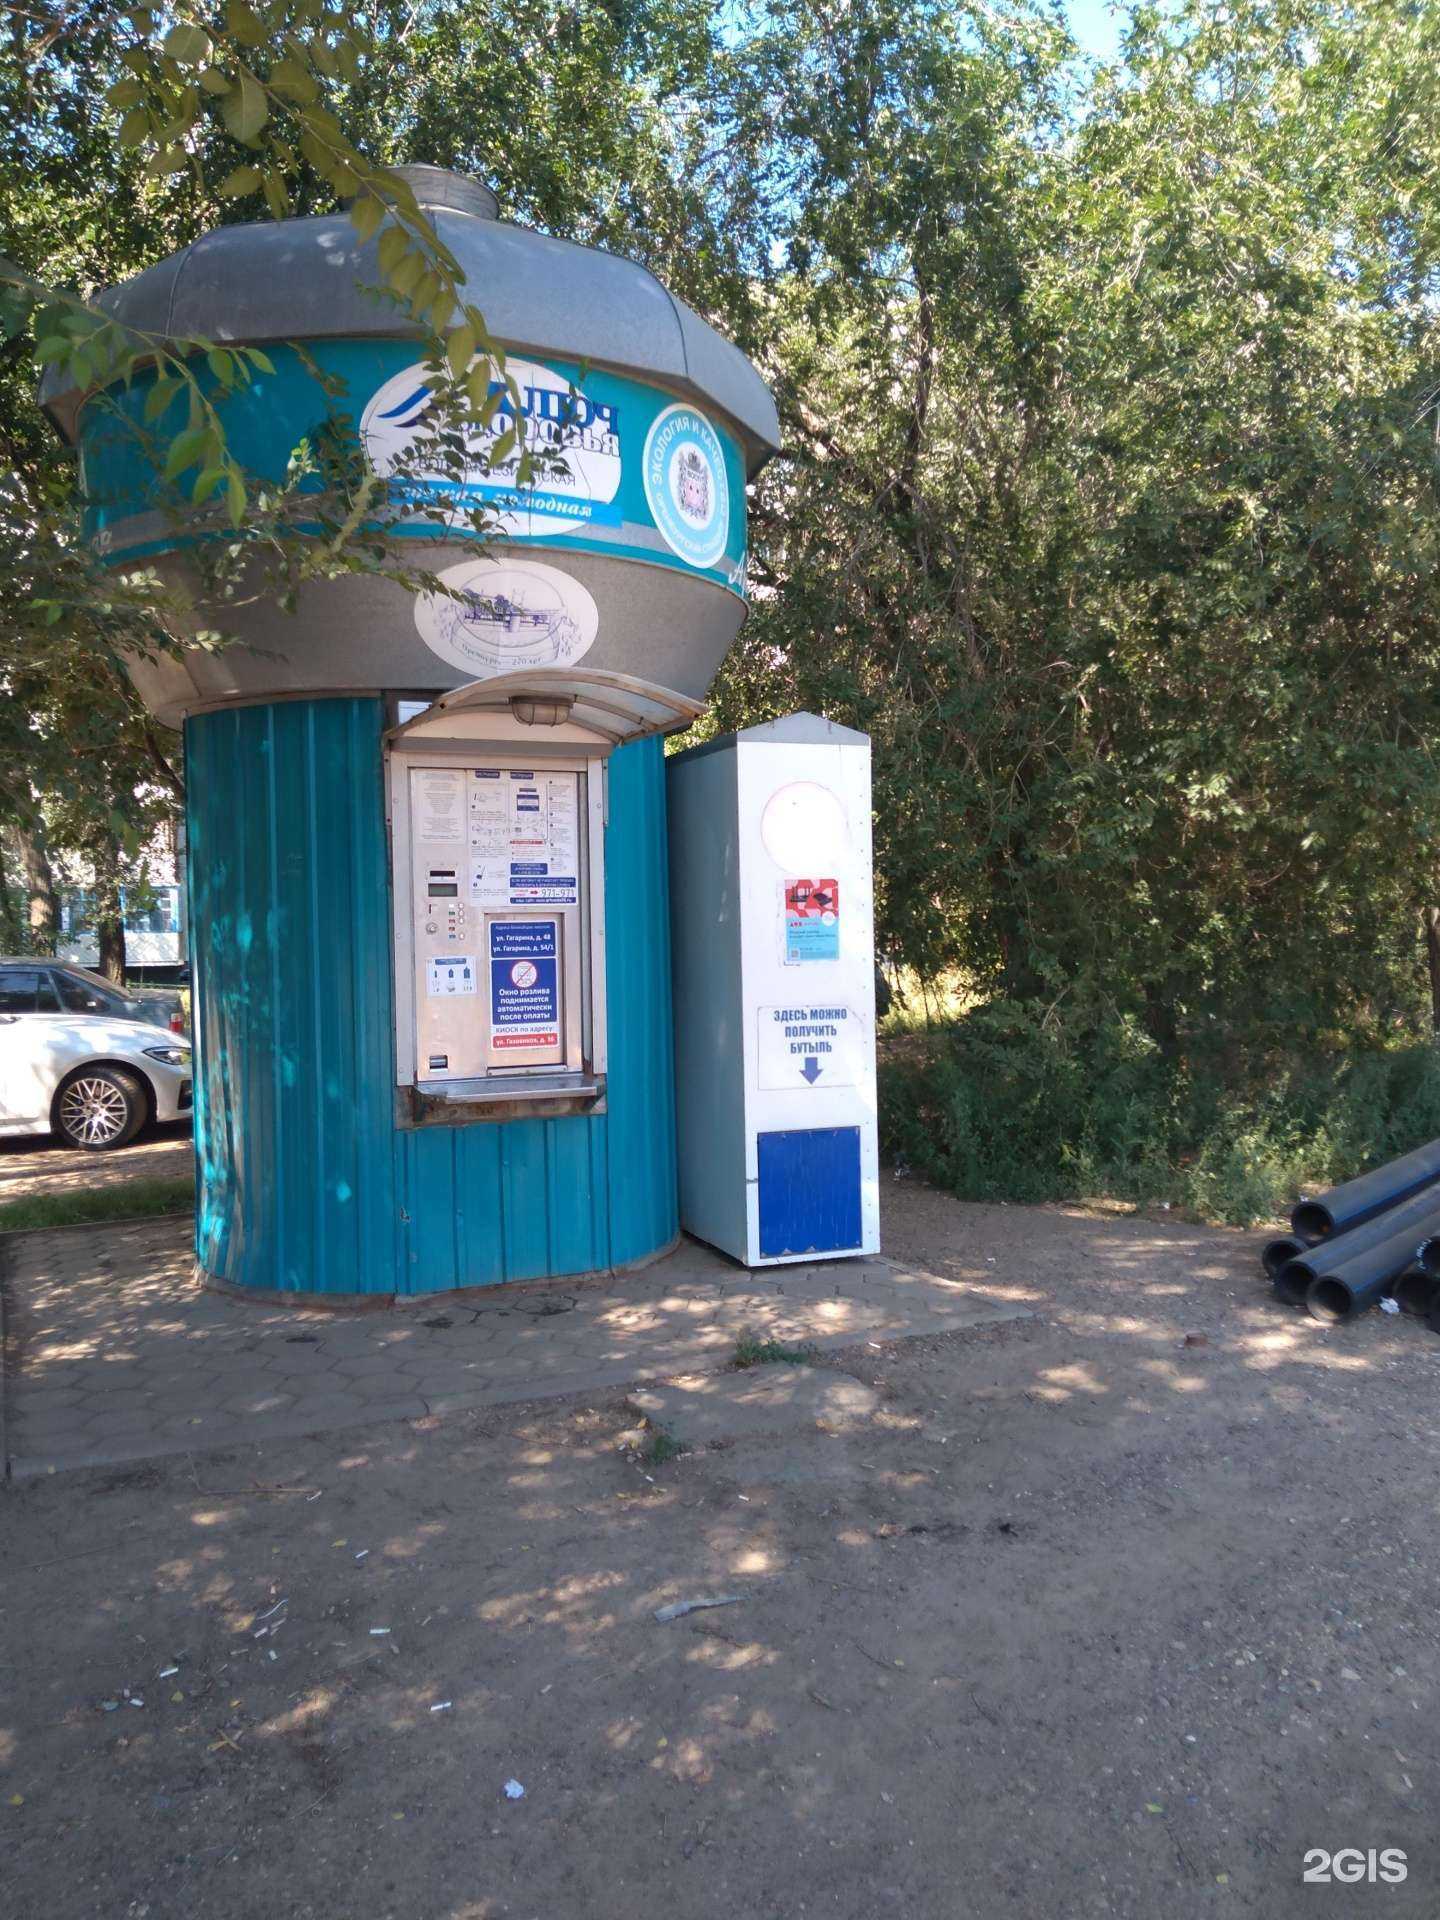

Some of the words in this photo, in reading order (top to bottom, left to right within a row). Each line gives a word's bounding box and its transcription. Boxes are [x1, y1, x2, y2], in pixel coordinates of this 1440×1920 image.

[652, 416, 690, 485] ЭКОЛОГИЯ
[541, 888, 574, 897] 971-971
[499, 988, 519, 996] Окно
[520, 987, 550, 997] розлива
[500, 996, 549, 1005] поднимается
[497, 1004, 553, 1013] автоматически
[773, 1009, 808, 1023] ЗДЕСЬ
[809, 1008, 848, 1020] МОЖНО
[784, 1025, 838, 1038] ПОЛУЧИТЬ
[790, 1041, 832, 1054] БУТЫЛЬ
